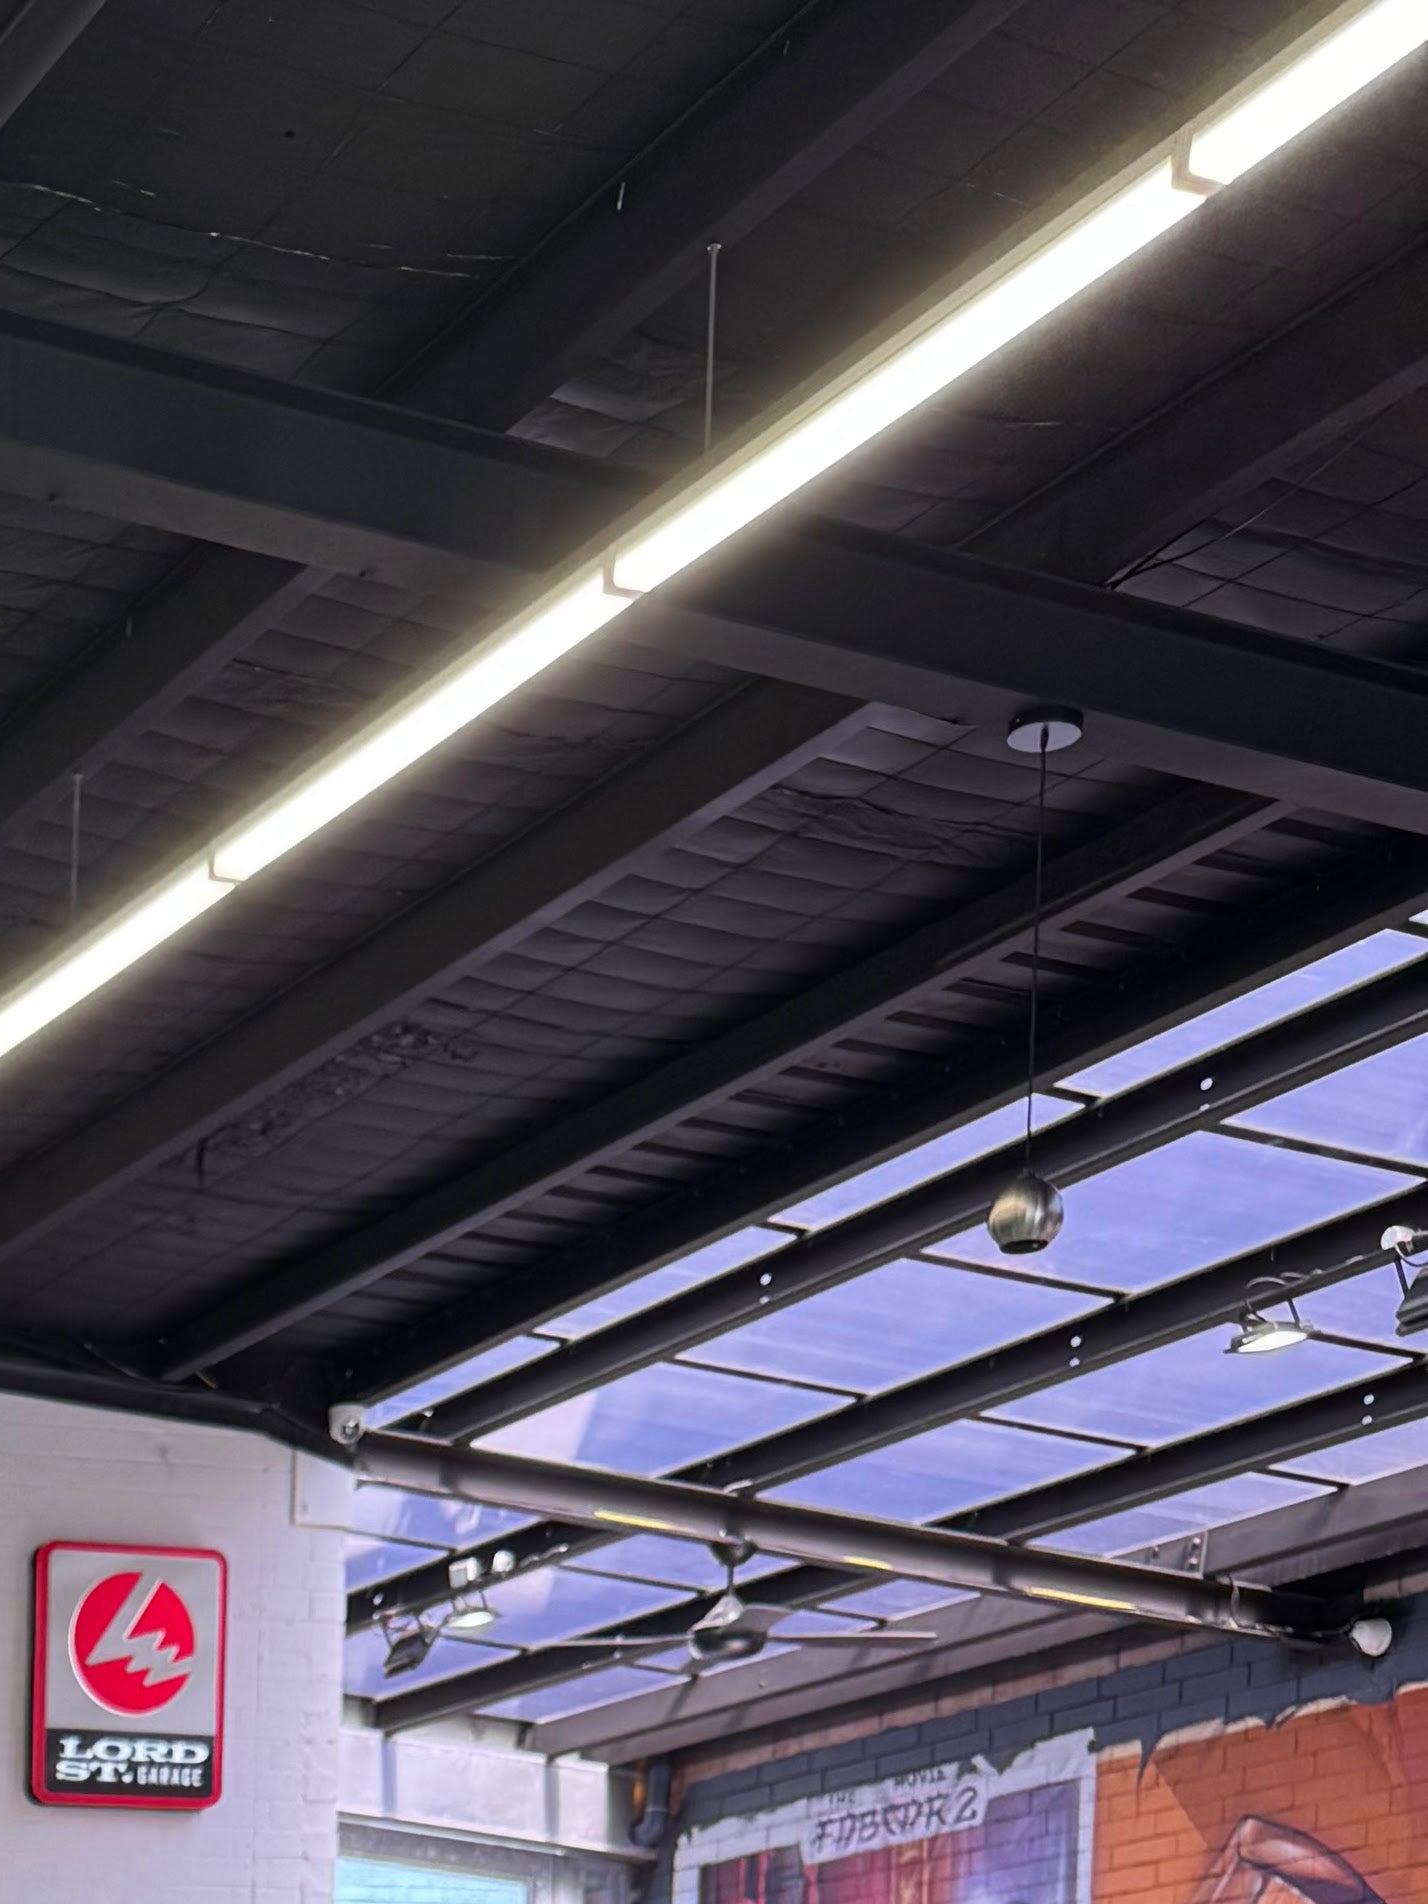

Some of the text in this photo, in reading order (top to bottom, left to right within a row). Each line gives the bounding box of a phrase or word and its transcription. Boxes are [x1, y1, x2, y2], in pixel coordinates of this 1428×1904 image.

[58, 1735, 210, 1765] LORD
[55, 1759, 204, 1788] ST. GARAGE
